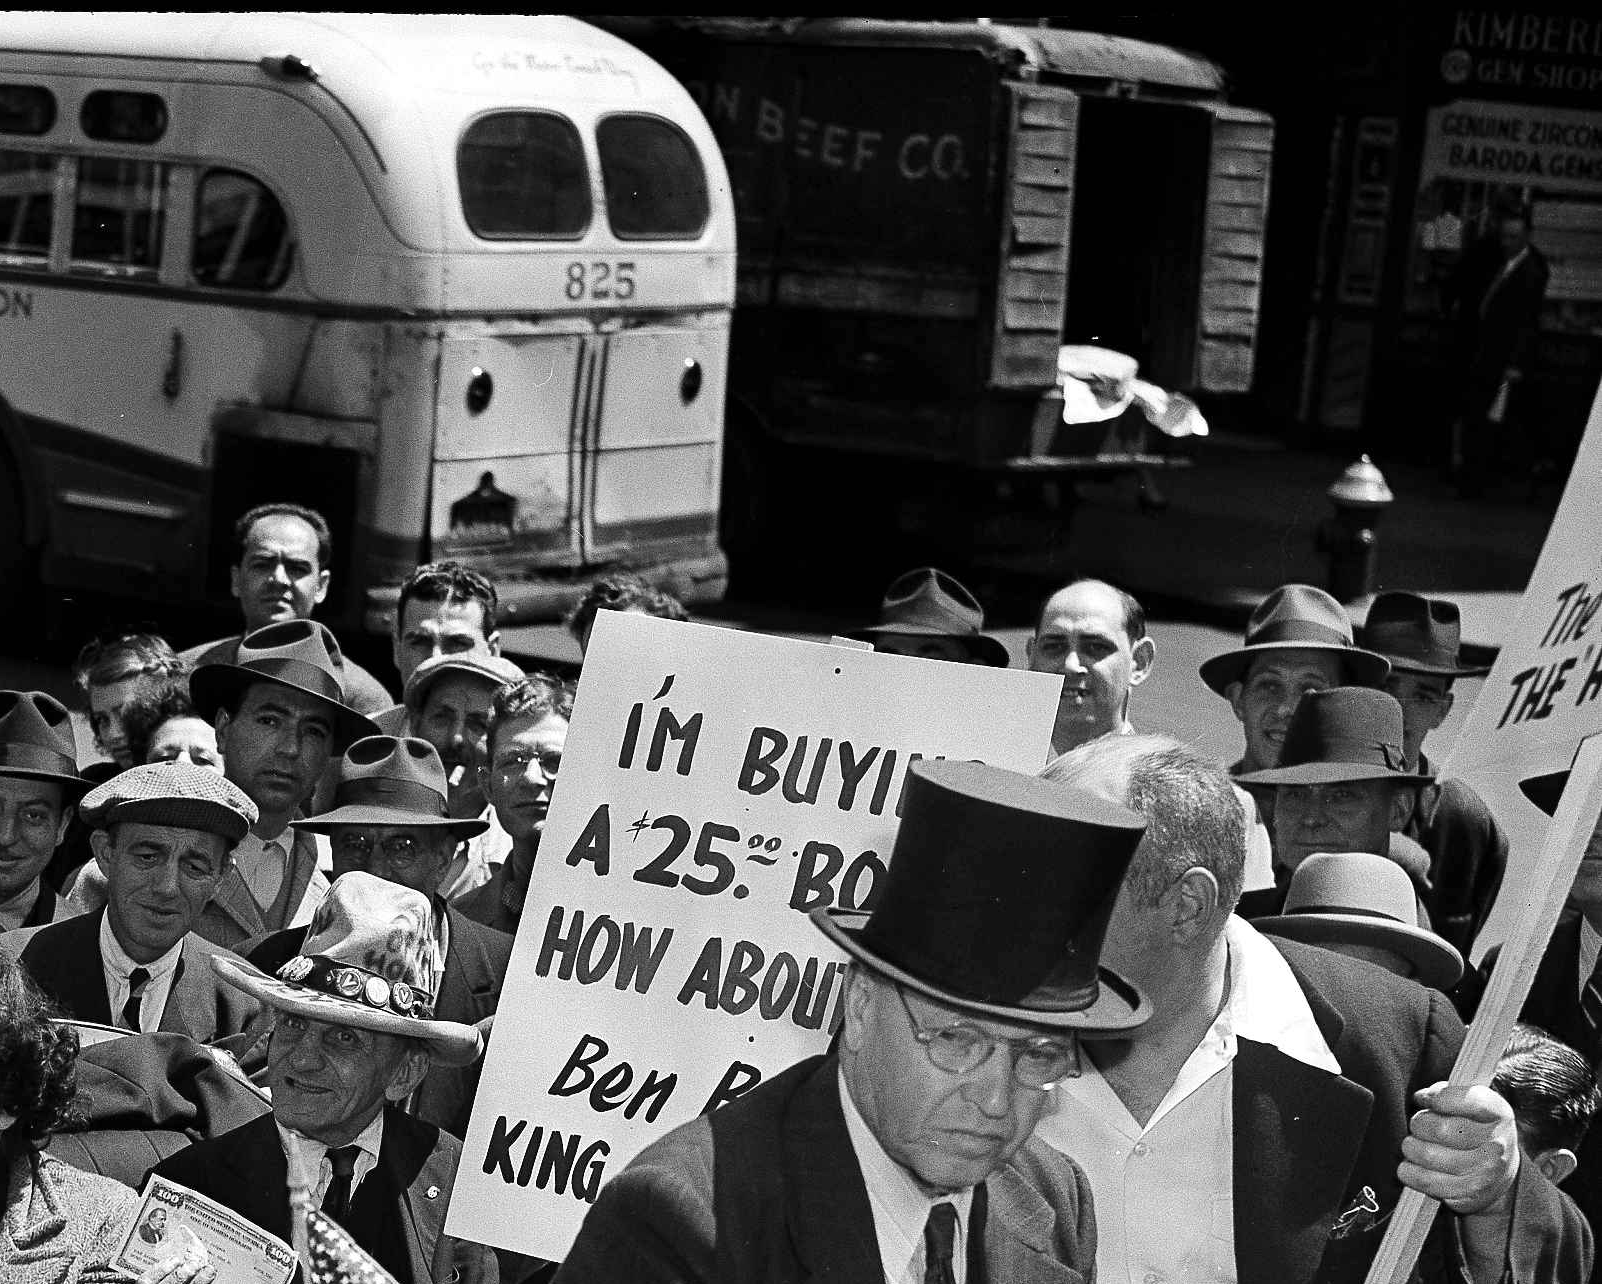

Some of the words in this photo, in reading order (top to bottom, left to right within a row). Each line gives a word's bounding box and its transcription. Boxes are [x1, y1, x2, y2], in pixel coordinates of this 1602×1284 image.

[755, 98, 882, 173] BEEF
[1442, 112, 1523, 142] GENUINE
[1449, 143, 1543, 176] BARODA
[565, 262, 636, 300] 825
[617, 675, 703, 777] I'M
[1496, 657, 1578, 730] THE
[565, 804, 611, 876] A
[535, 905, 675, 995] HOW
[549, 1034, 679, 1123] Ben
[482, 1116, 611, 1204] KING
[157, 1188, 180, 1205] 100
[270, 1246, 291, 1263] 100
